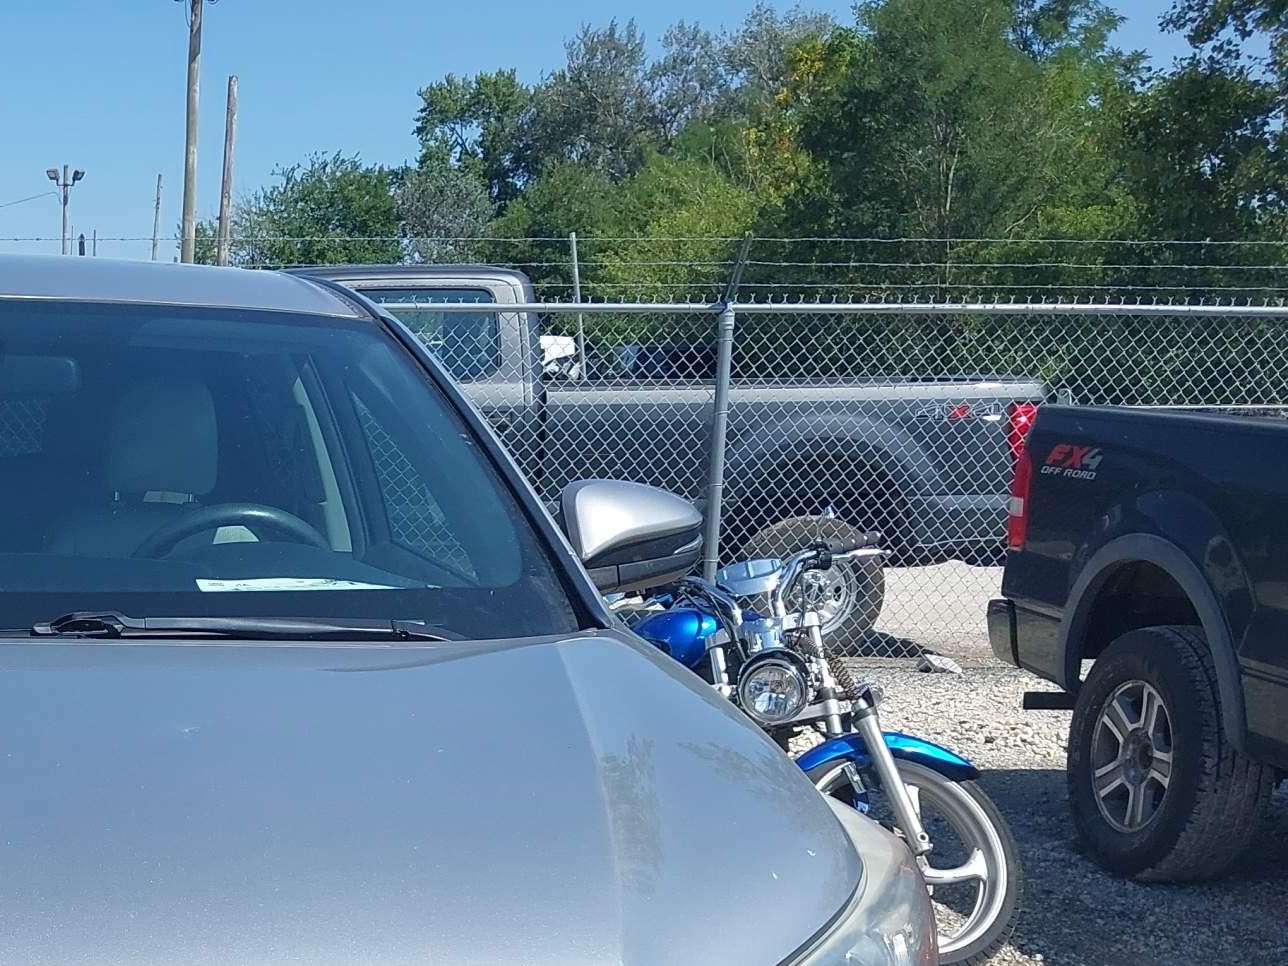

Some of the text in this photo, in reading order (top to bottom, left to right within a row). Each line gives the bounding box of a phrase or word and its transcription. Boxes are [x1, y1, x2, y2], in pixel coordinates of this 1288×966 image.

[1045, 444, 1103, 470] FX4
[1040, 465, 1097, 480] OFF ROAD
